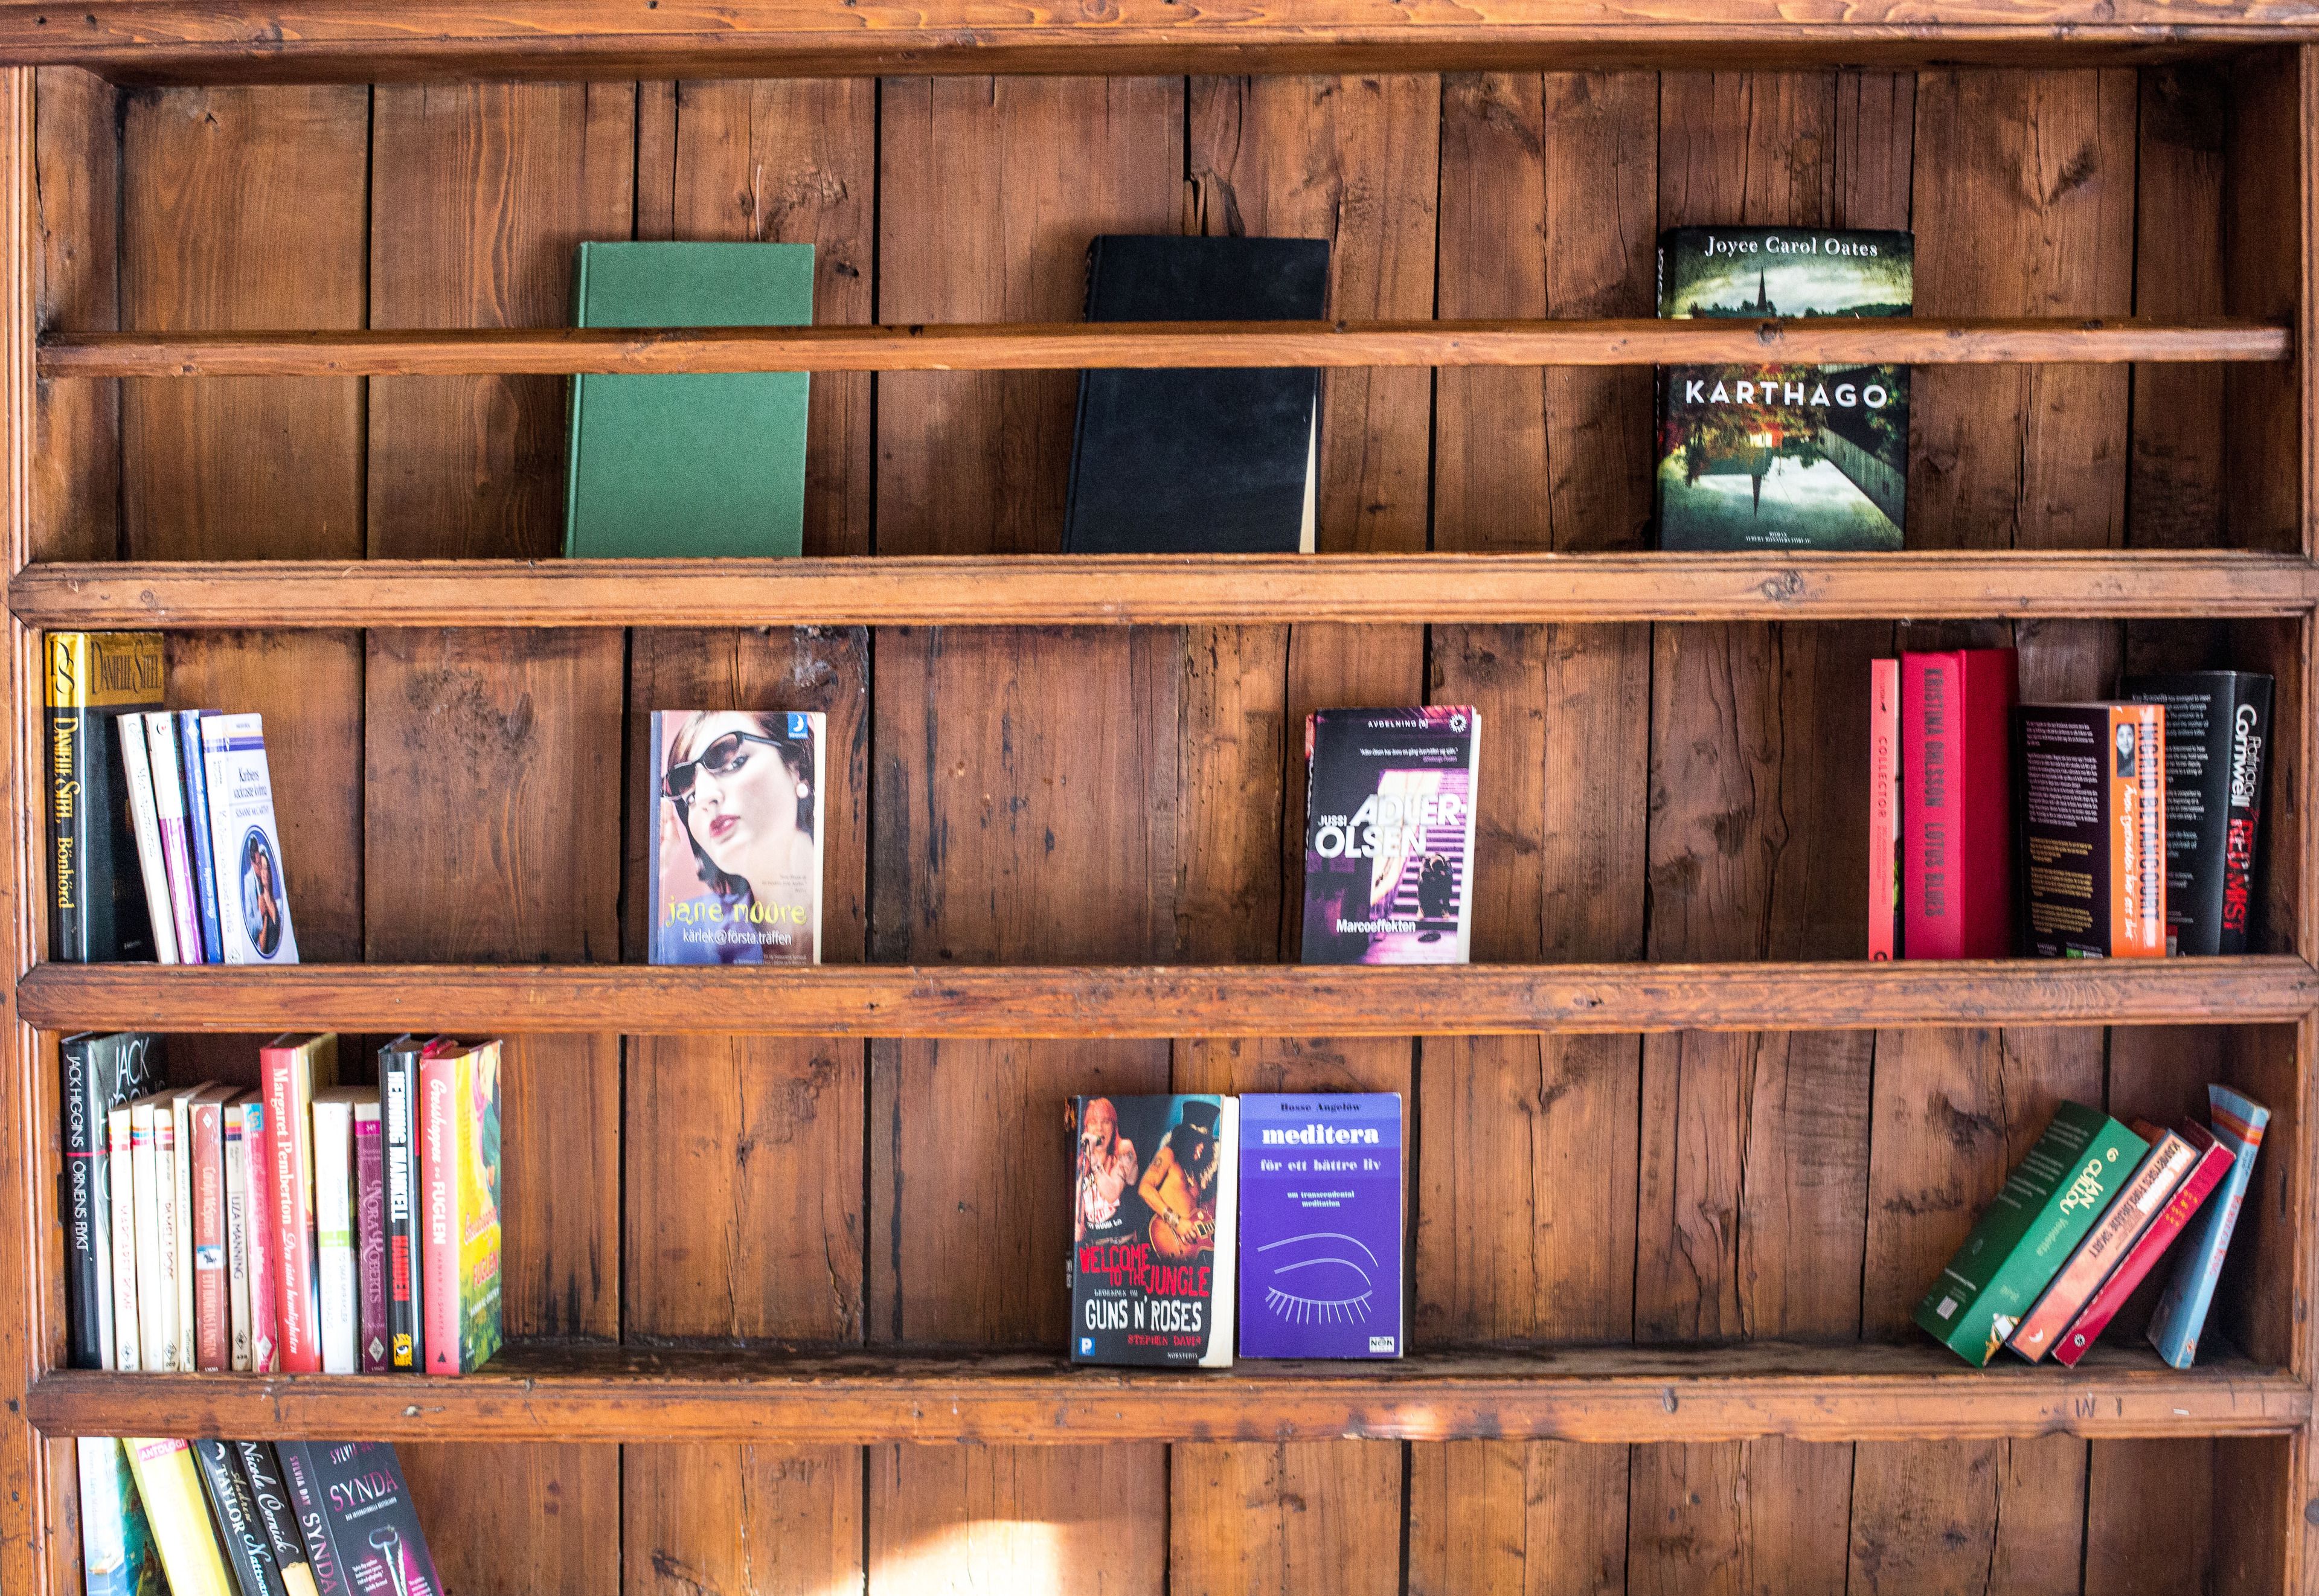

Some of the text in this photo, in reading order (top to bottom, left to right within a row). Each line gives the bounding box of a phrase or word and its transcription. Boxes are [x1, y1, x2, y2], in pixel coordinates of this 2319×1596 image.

[1705, 236, 1878, 257] Joyce Carol Oates
[1686, 380, 1887, 408] KARTHAGO
[1367, 719, 1417, 728] AVDELNING
[1878, 736, 1888, 819] COLLECTOR
[2231, 703, 2257, 807] Cornwell
[2243, 736, 2262, 796] Patricia
[1924, 668, 1945, 918] KRISTINA OHLSSON LOTUS BLUES
[1315, 825, 1427, 858] OLSEN
[1318, 815, 1347, 827] JUSSI
[2138, 722, 2160, 921] INGRID BETANCOURT
[58, 836, 75, 909] Bönhörd
[2224, 818, 2254, 934] RED MIST
[666, 895, 807, 928] jane moore
[1336, 918, 1416, 933] Marcoeffekten
[112, 1037, 150, 1098] JACK
[271, 1068, 289, 1136] Margaret
[388, 1071, 407, 1144] HENNING
[426, 1078, 447, 1164] Gresshoppen
[1281, 1102, 1312, 1112] Bosse
[66, 1054, 89, 1252] JACK HIGGINS ÖRNENS FLYKT
[1262, 1124, 1379, 1145] meditera
[2106, 1147, 2119, 1162] 6
[277, 1141, 295, 1224] Pemberton
[390, 1146, 409, 1223] MANKELL
[1260, 1158, 1381, 1171] för ett bättre liv
[2059, 1159, 2103, 1216] GUILLOU
[432, 1181, 447, 1245] FUGLEN
[1301, 1199, 1341, 1208] meditation
[2079, 1178, 2104, 1210] JAN
[231, 1196, 244, 1280] LIZA MANNING
[363, 1179, 383, 1303] NORA ROBERTS
[1079, 1243, 1151, 1274] WELCOME
[473, 1249, 499, 1289] FUGLEN
[1109, 1267, 1147, 1286] TO THE
[1145, 1265, 1211, 1298] JUNGLE
[1085, 1298, 1128, 1330] GUNS
[1150, 1300, 1202, 1332] ROSES
[1127, 1334, 1169, 1346] STEPHEN
[140, 1438, 186, 1461] ANTOLOGI
[330, 1442, 358, 1465] SYLVIA
[214, 1464, 245, 1536] TAYLOR
[230, 1470, 252, 1523] Andrew
[240, 1441, 300, 1555] Nicola Cornick
[330, 1467, 399, 1513] SYNDA
[289, 1455, 338, 1595] SYLVIA DAY SYNDA
